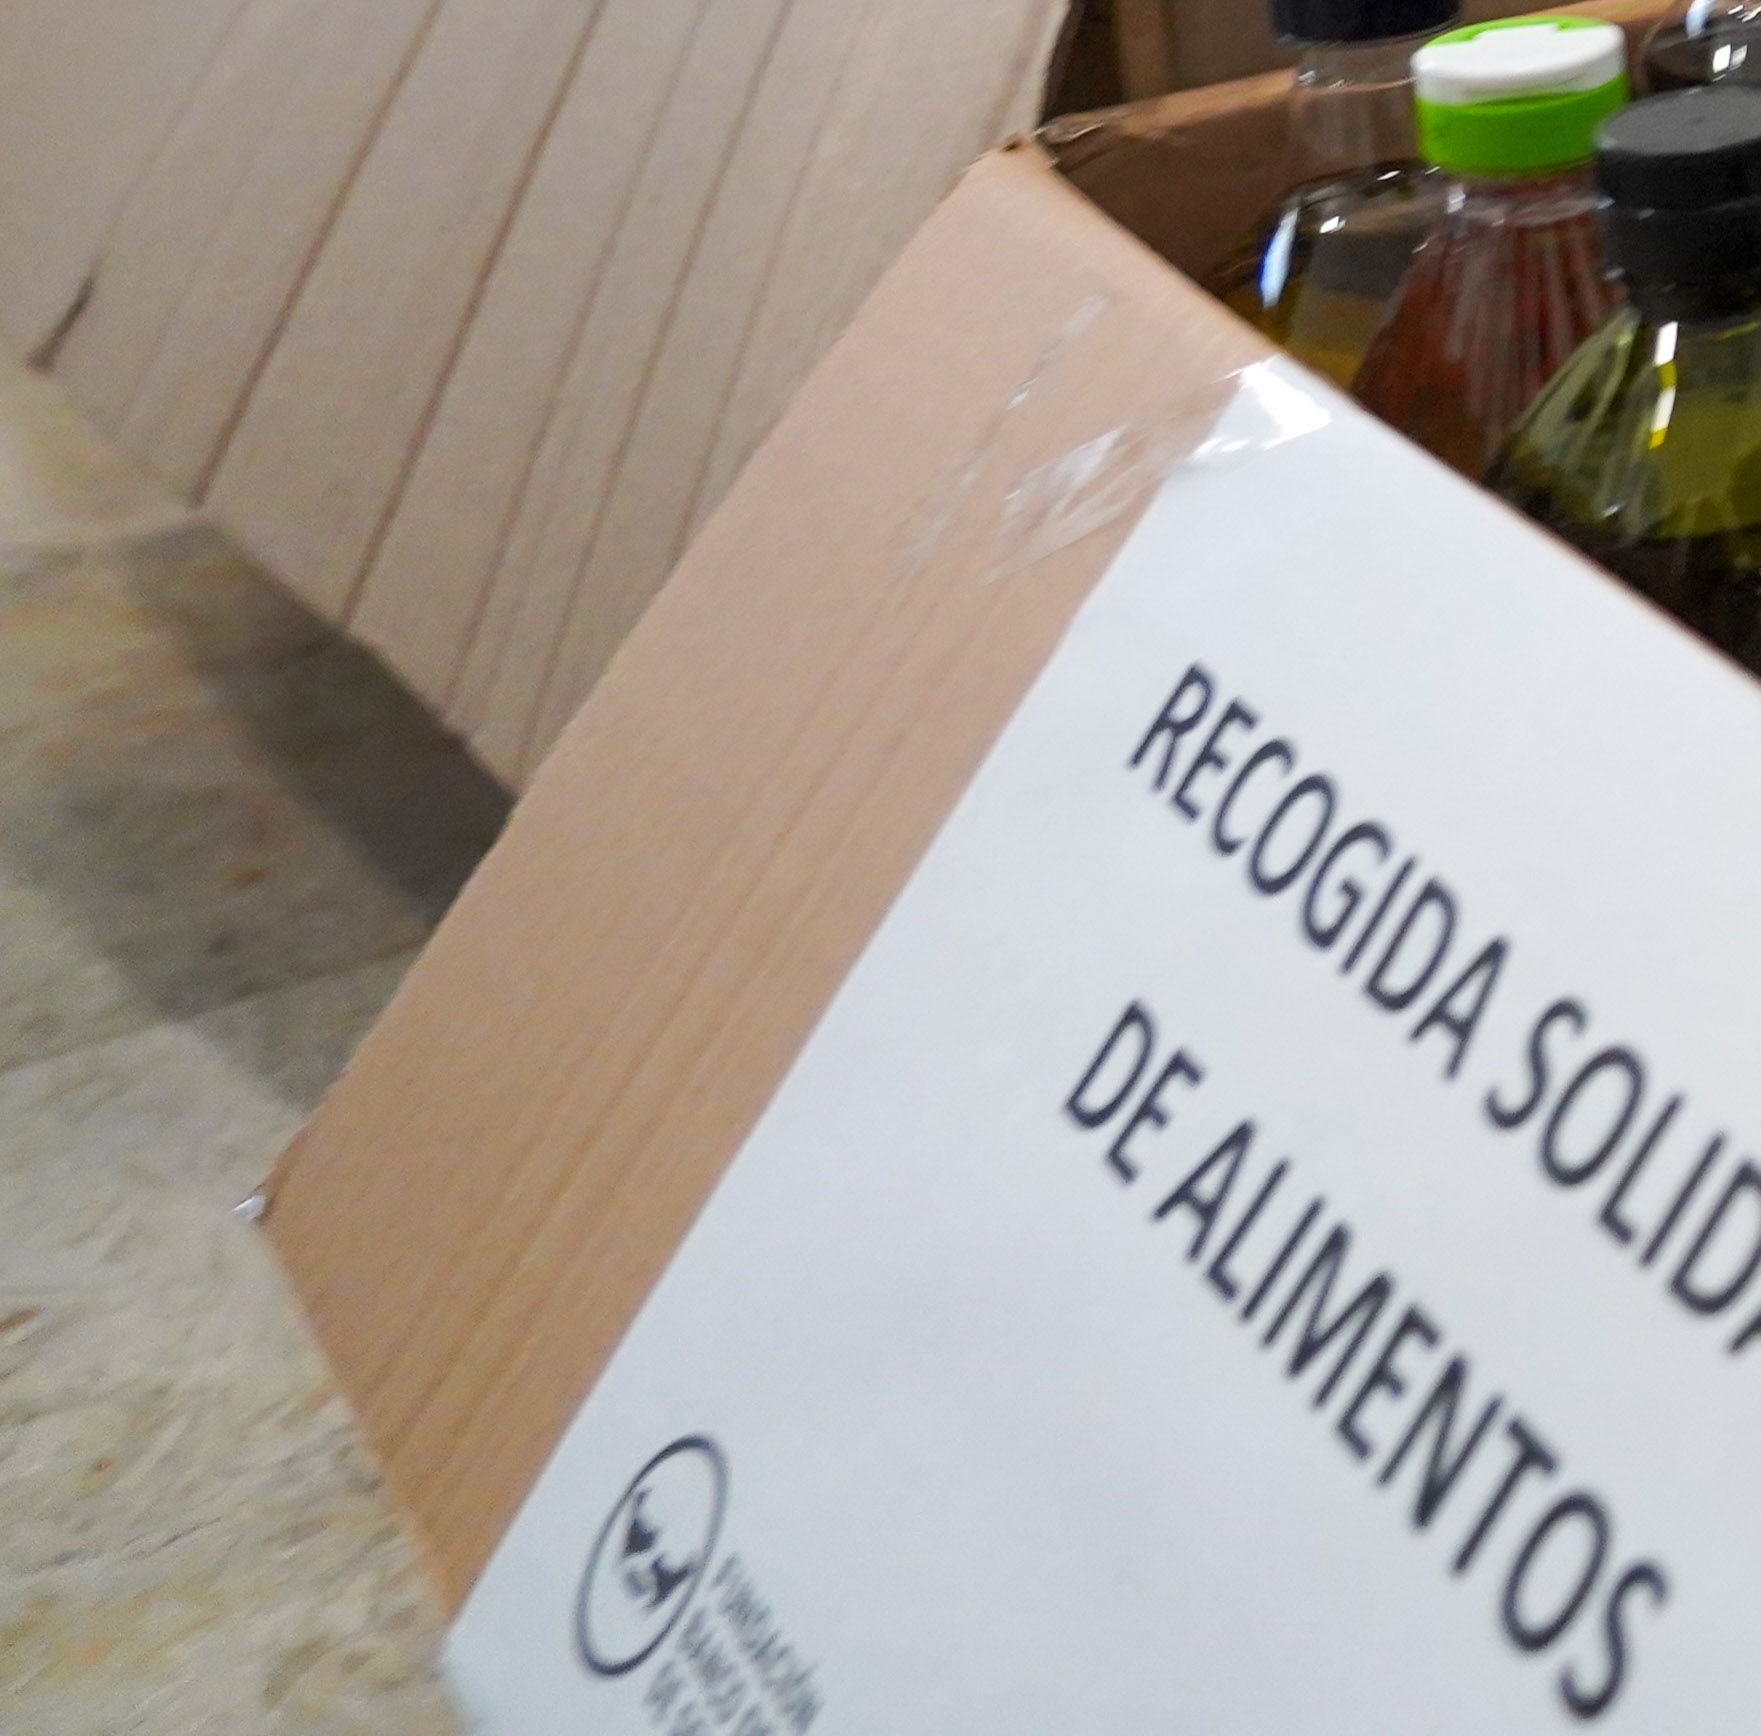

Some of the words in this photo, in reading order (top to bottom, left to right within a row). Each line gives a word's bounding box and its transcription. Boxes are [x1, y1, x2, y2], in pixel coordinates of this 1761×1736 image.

[1126, 661, 1511, 1081] RECOGIDA
[1062, 999, 1204, 1184] DE
[1152, 1117, 1671, 1723] ALIMENTOS
